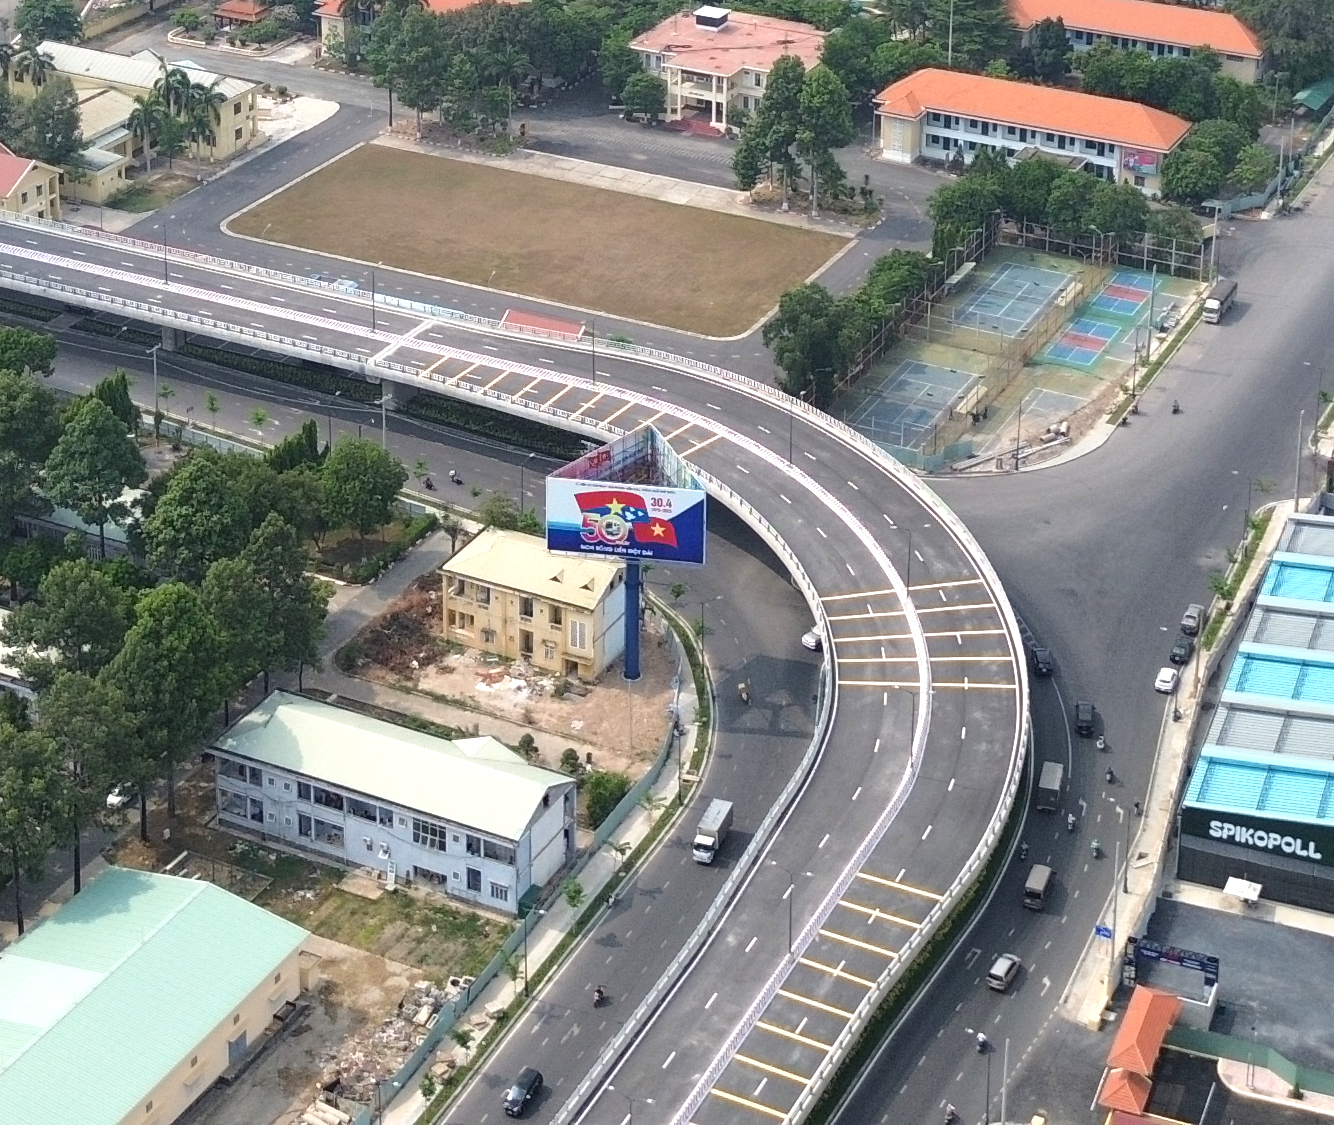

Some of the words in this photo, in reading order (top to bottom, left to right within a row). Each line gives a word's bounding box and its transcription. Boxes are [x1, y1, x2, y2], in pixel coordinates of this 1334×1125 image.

[651, 497, 672, 508] 30.4
[580, 512, 628, 545] 50
[1209, 820, 1322, 860] SPIKOPOLL
